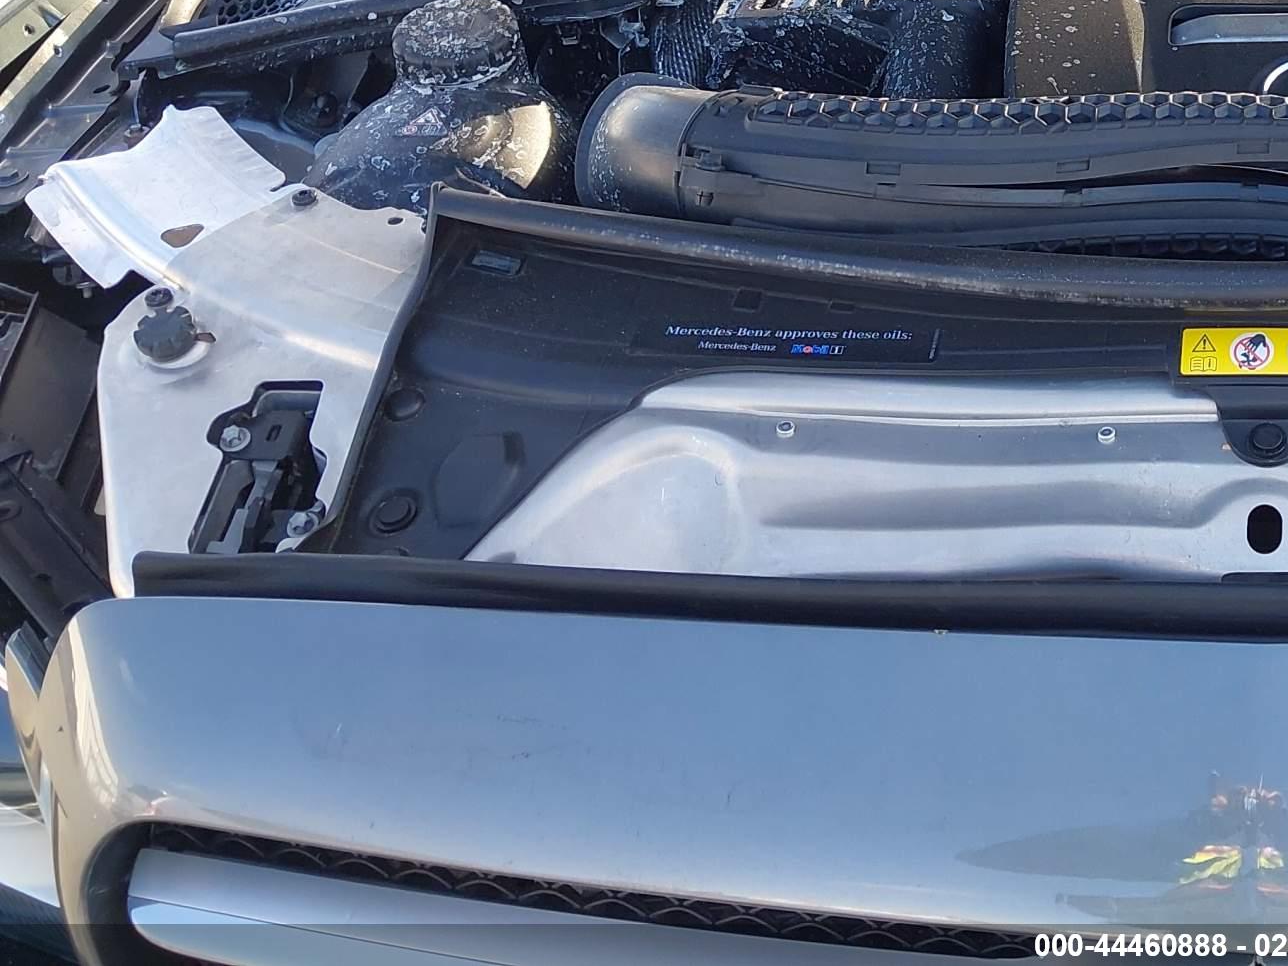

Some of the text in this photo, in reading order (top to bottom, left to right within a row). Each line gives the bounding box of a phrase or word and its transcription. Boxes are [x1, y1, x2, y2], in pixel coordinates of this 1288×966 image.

[665, 325, 913, 340] Mercedes-Benz approves these oils:
[697, 340, 777, 352] Mercedes-Benz
